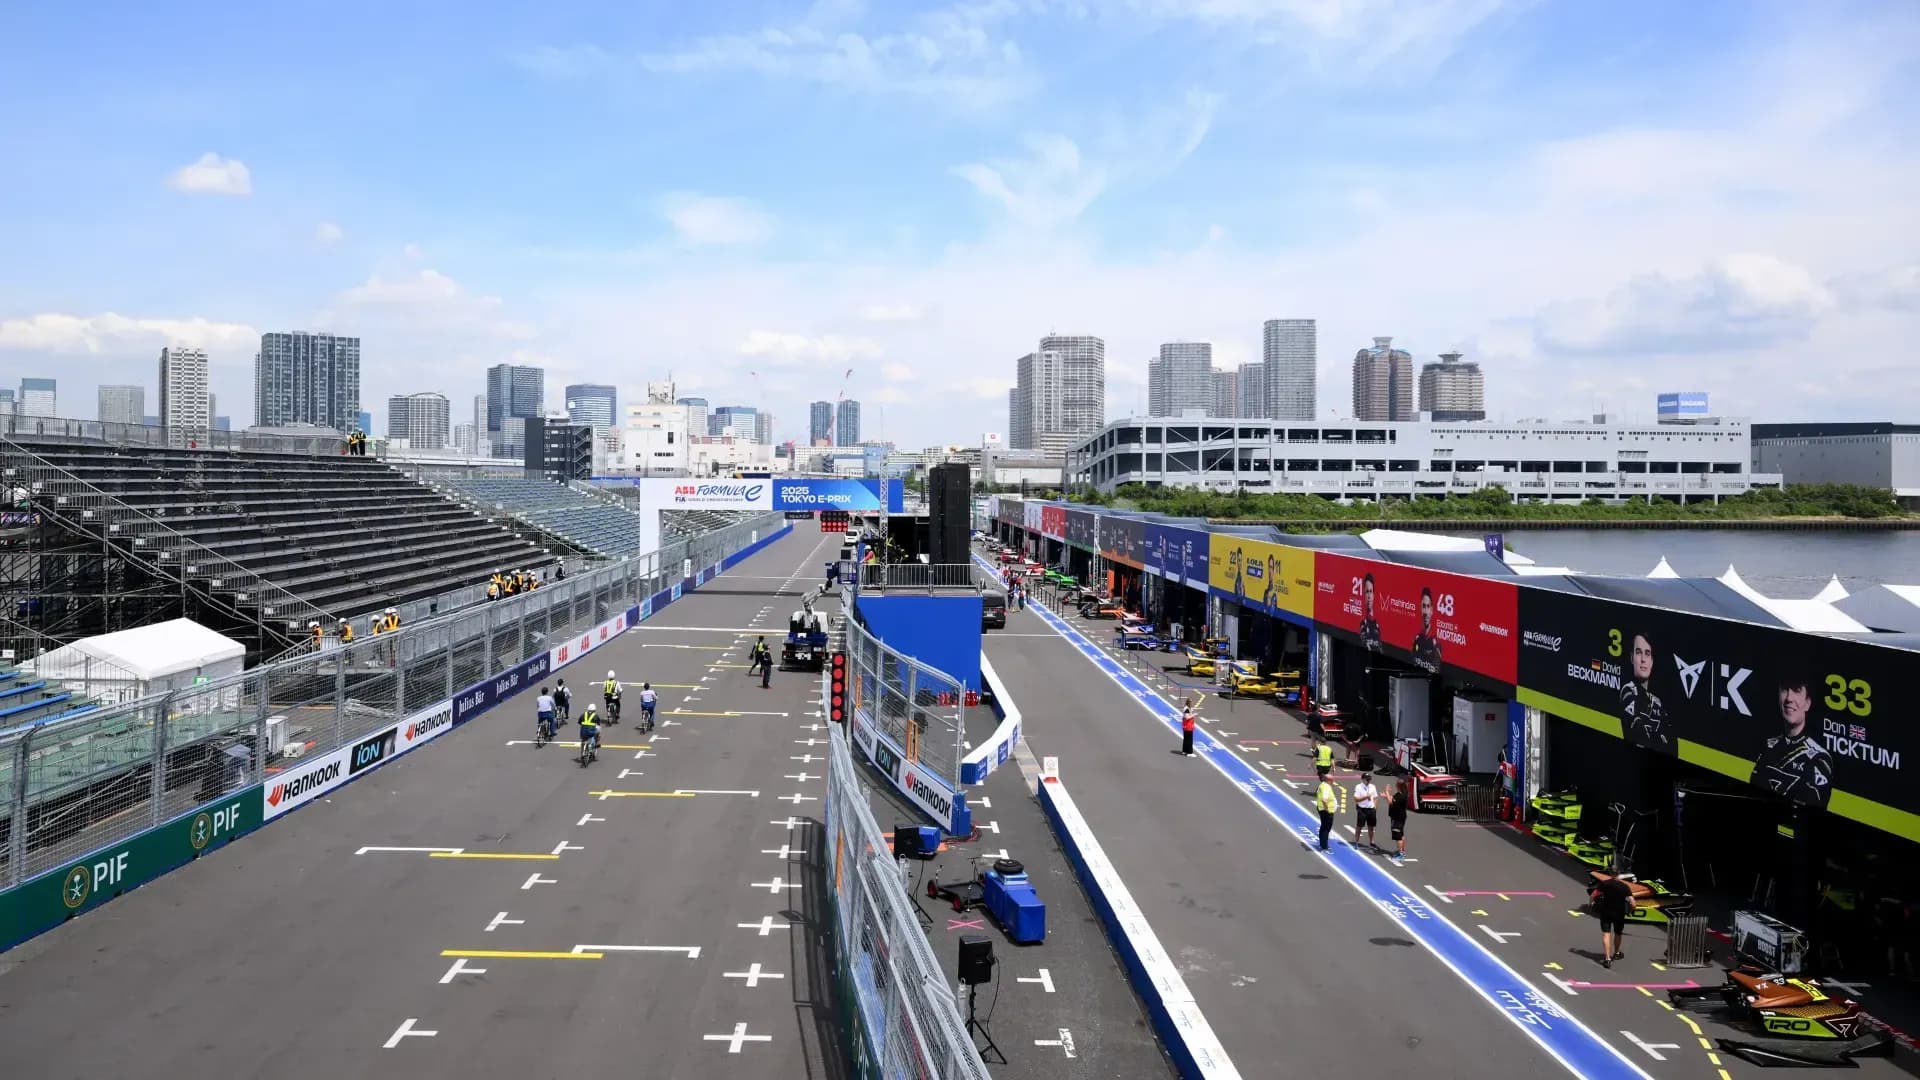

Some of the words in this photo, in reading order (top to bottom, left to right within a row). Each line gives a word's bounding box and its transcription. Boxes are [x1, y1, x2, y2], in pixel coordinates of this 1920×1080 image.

[675, 486, 695, 494] ABB
[696, 485, 745, 496] FORMULA
[781, 486, 810, 494] 2025
[781, 495, 816, 504] TOKYO
[817, 495, 852, 504] E-PRIX
[1352, 576, 1363, 596] 21
[1390, 598, 1416, 611] mahindra
[1437, 593, 1454, 616] 48
[581, 634, 590, 652] ABB
[1436, 628, 1467, 646] MORTARA
[1607, 628, 1622, 657] 3
[557, 645, 568, 664] ABB
[1567, 663, 1621, 691] BECKMANN
[1602, 661, 1621, 676] David
[496, 679, 510, 697] Julius
[509, 673, 519, 686] Bär
[458, 697, 475, 717] Julius
[475, 690, 486, 706] Bär
[1823, 674, 1872, 717] 33
[1823, 718, 1846, 737] Dan
[1822, 733, 1900, 770] TICKTUM
[213, 802, 241, 837] PIF
[93, 851, 130, 892] PIF
